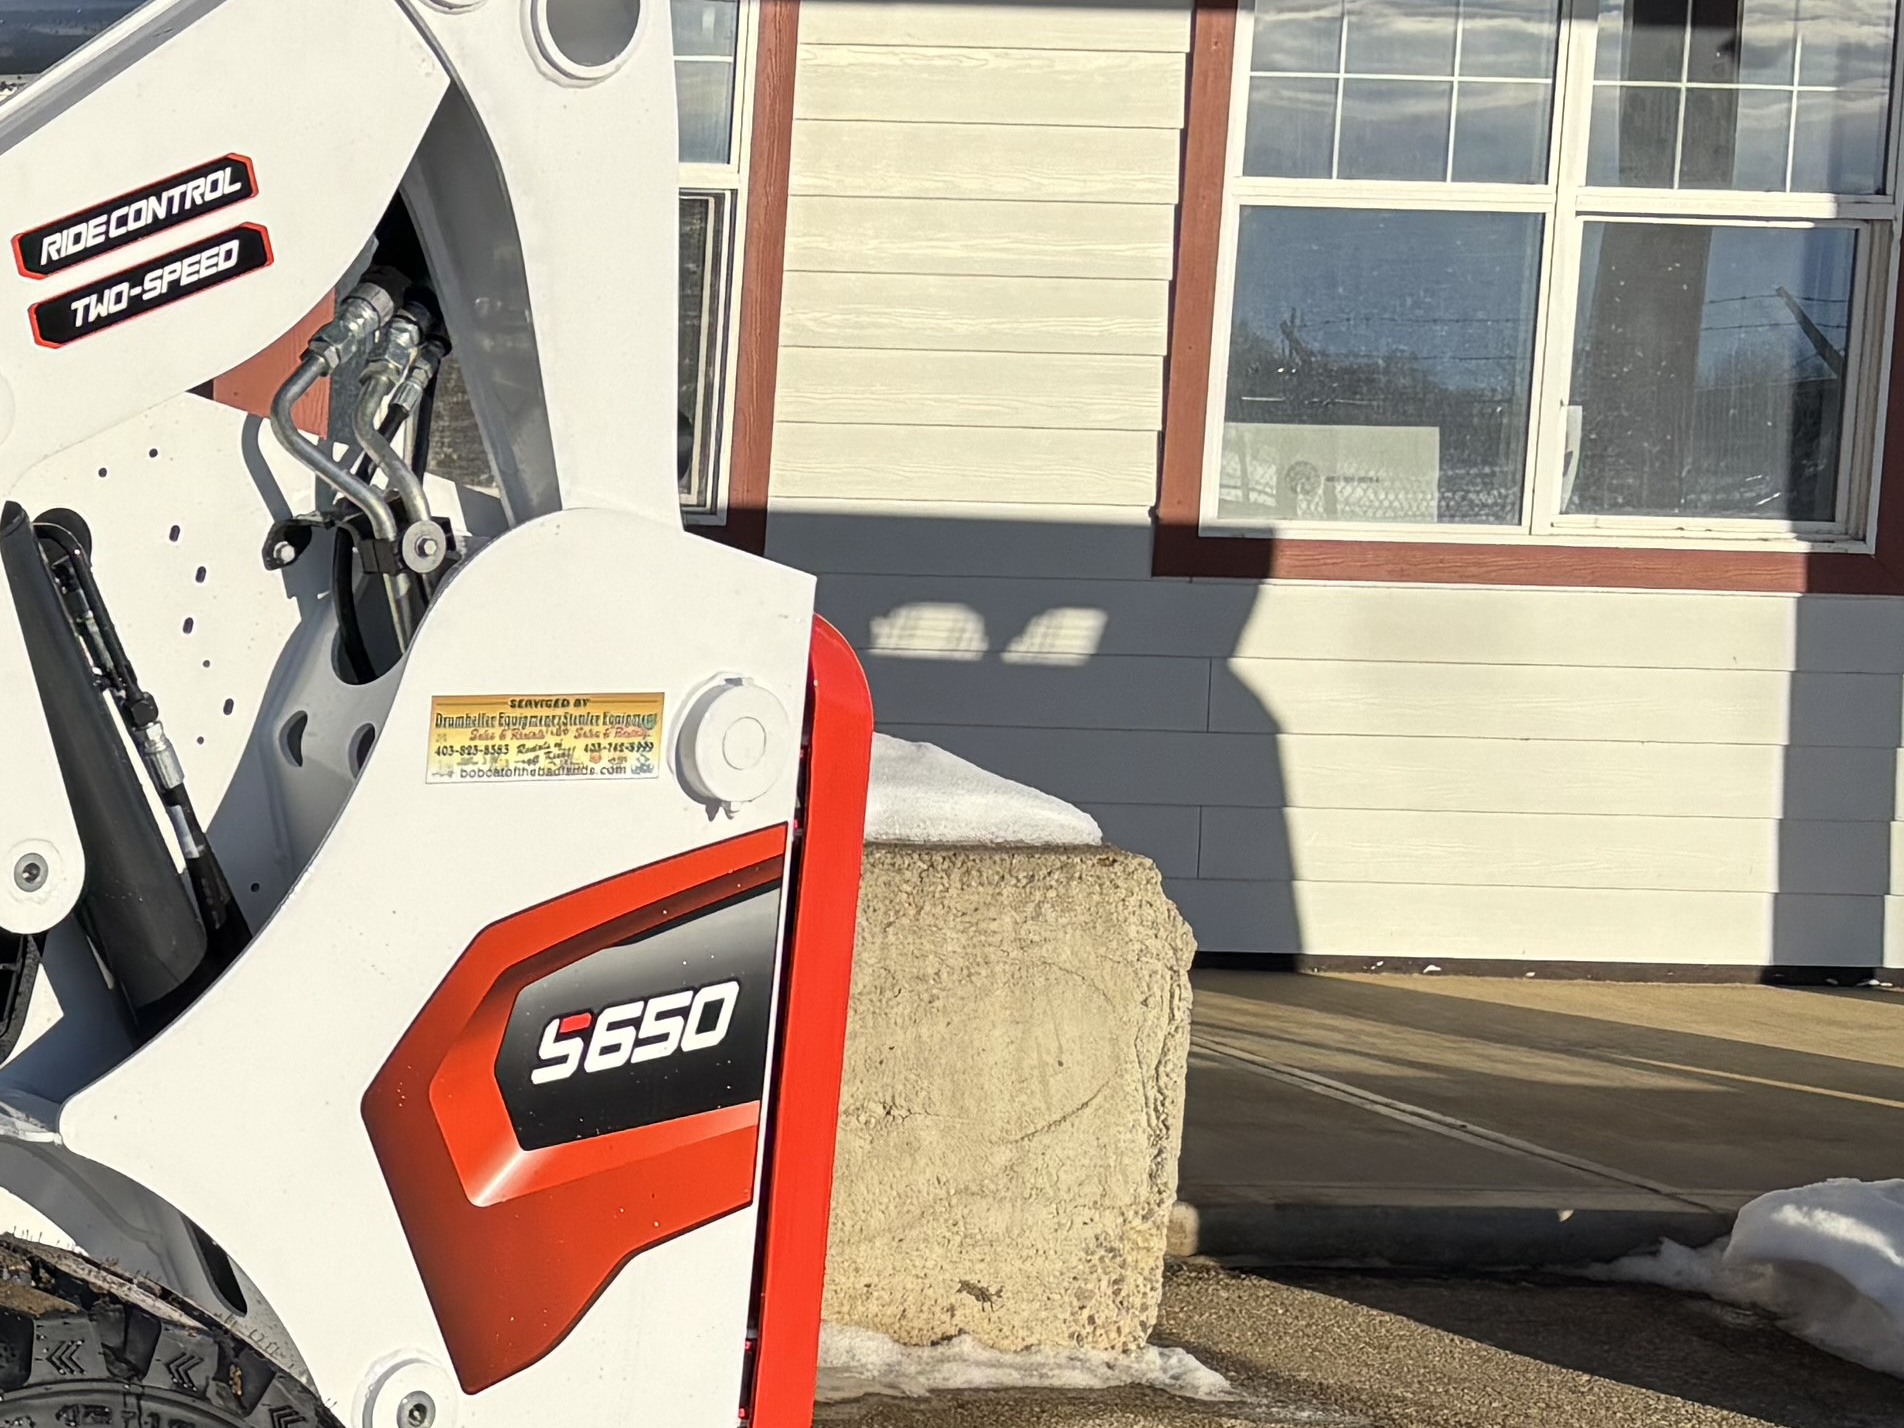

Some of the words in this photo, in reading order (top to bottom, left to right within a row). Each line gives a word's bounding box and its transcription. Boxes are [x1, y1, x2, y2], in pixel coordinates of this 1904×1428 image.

[40, 213, 109, 267] RIDE
[109, 167, 242, 238] CONTROL
[70, 239, 240, 329] TWO-SPEED
[573, 698, 590, 709] BY
[530, 980, 740, 1085] S650
